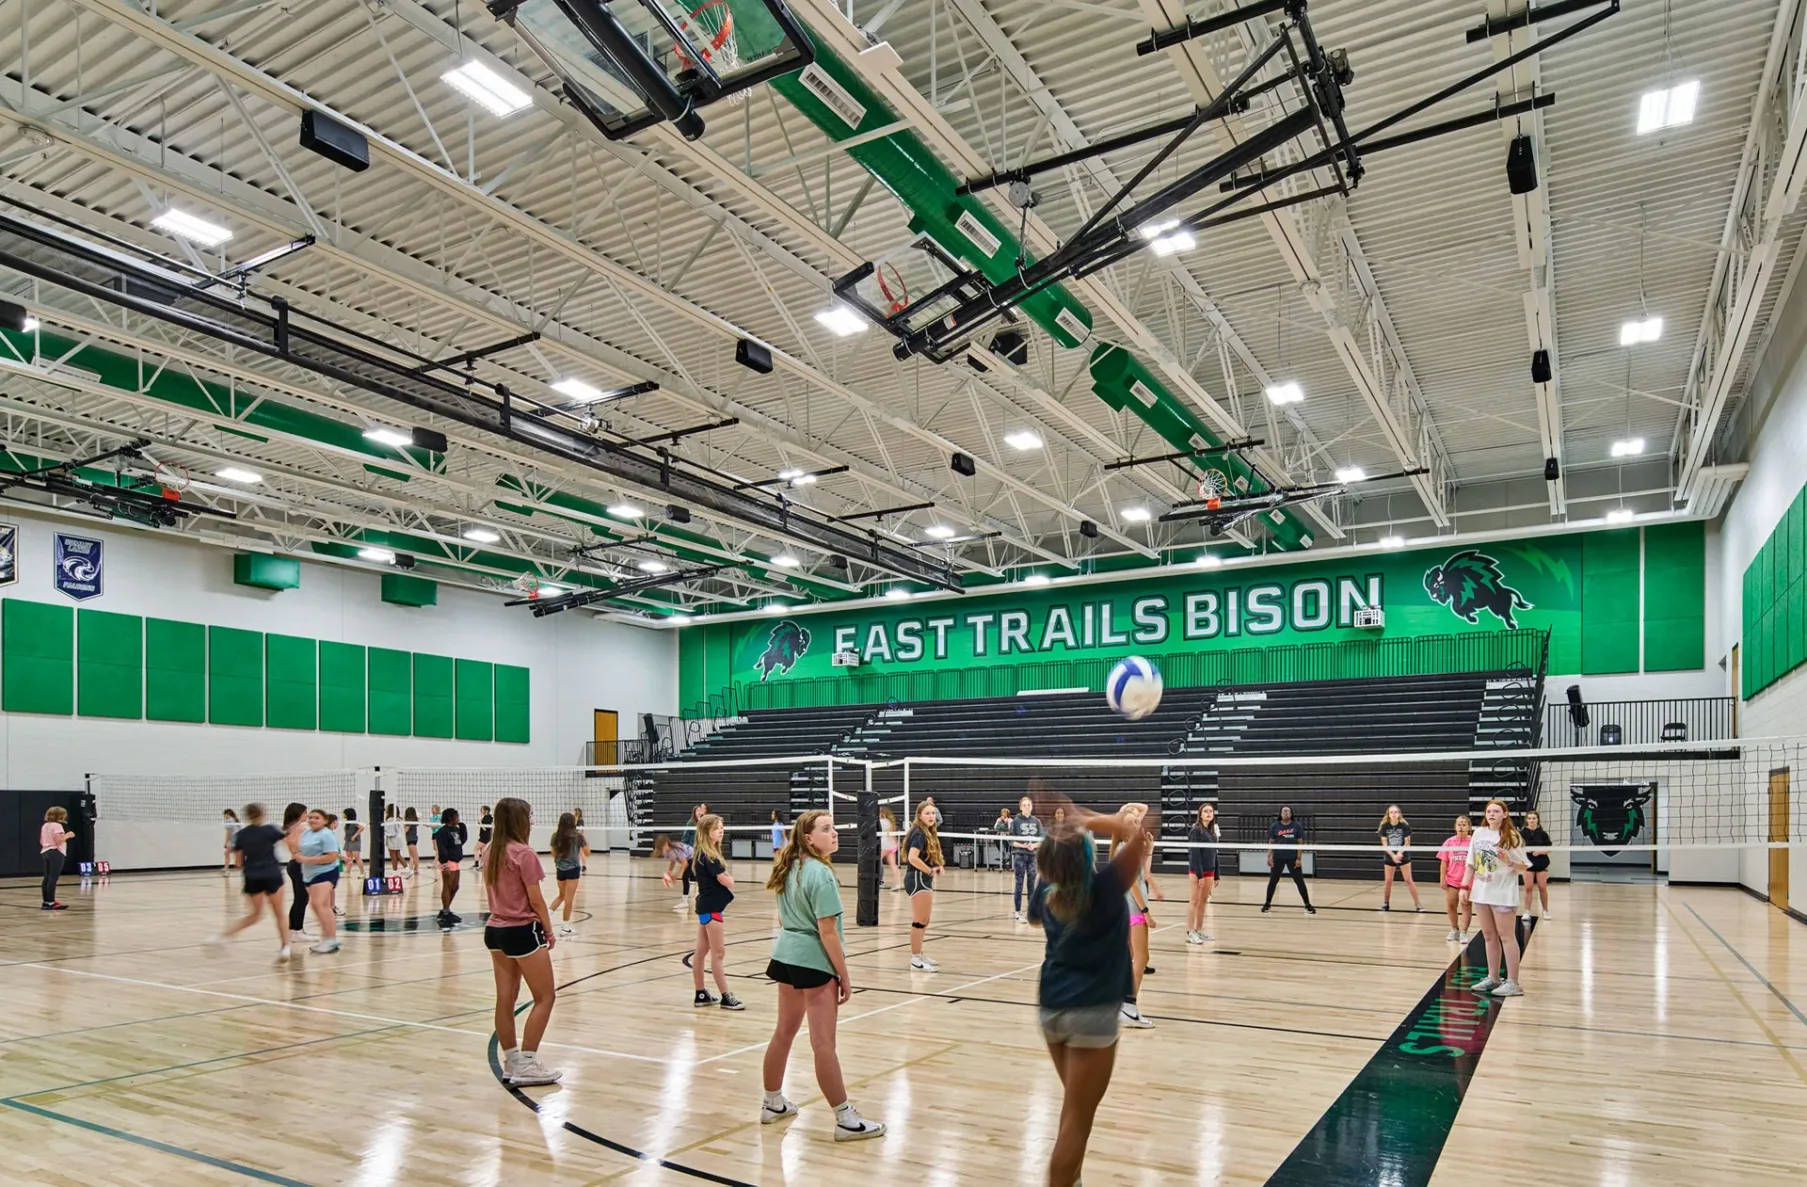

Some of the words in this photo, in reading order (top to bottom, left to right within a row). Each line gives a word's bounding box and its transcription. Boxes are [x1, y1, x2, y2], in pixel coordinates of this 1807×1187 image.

[833, 614, 956, 664] EAST
[964, 595, 1169, 657] TRAILS
[1183, 572, 1384, 641] BISON
[368, 878, 380, 890] 01
[387, 878, 401, 890] 02
[1398, 998, 1490, 1058] TRAILS
